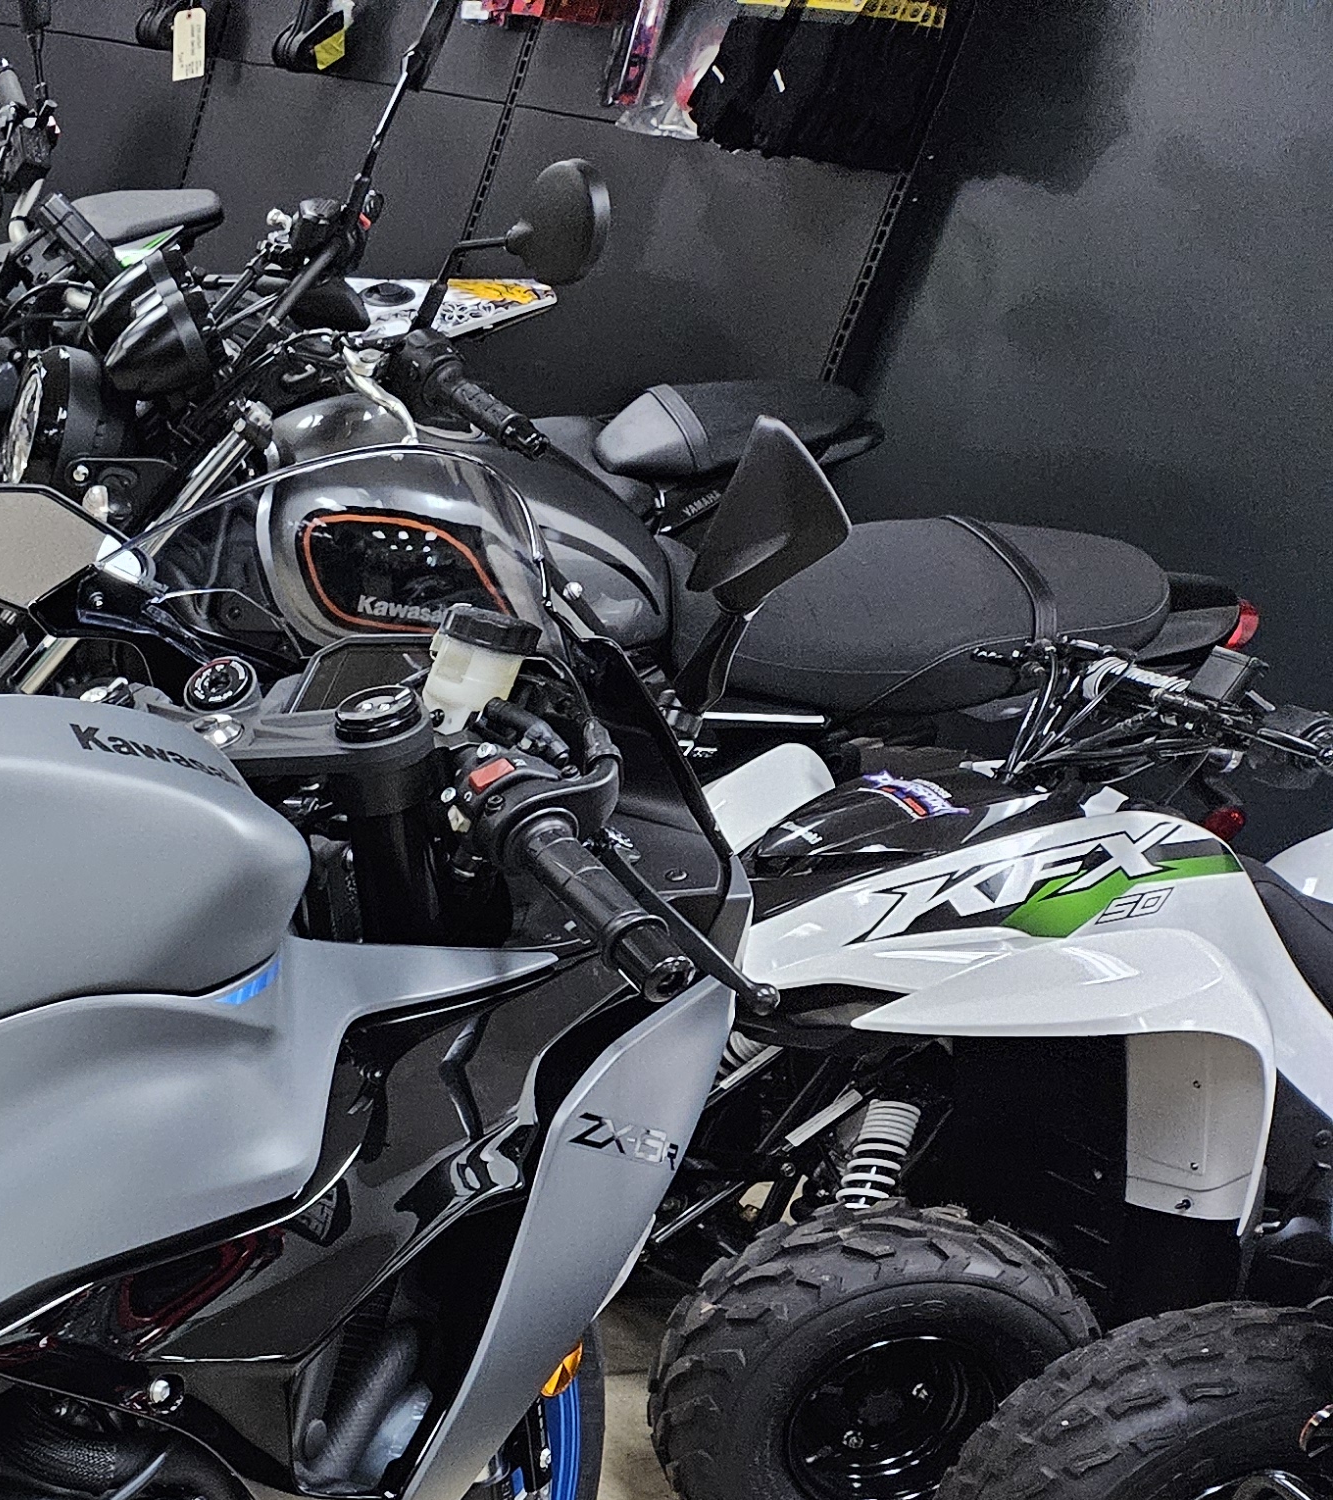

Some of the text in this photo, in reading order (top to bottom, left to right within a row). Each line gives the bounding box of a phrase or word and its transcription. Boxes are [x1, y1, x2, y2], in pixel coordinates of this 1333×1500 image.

[357, 594, 446, 623] Kawasa
[69, 722, 241, 787] Kawasa
[841, 821, 1183, 947] KFX
[1094, 886, 1175, 925] 50
[568, 1112, 679, 1172] ZX-6R
